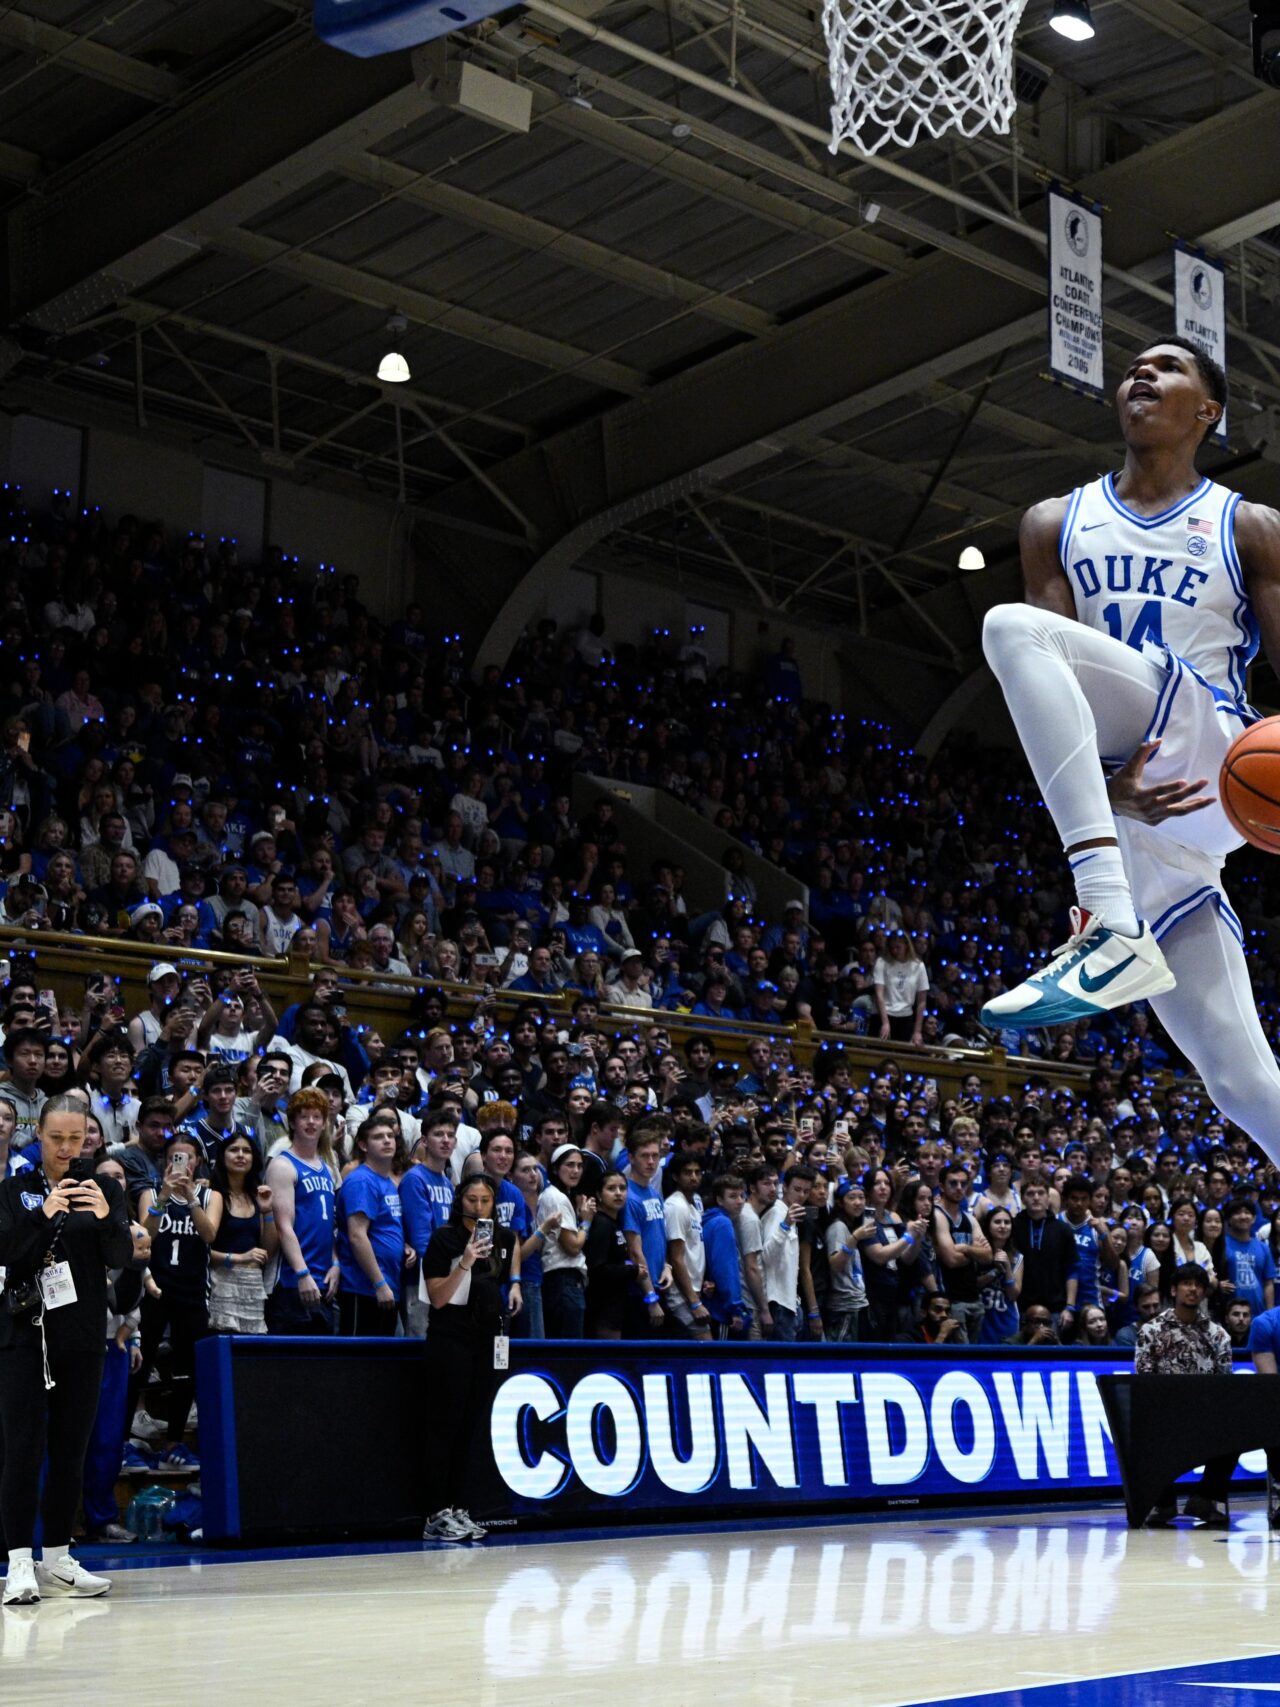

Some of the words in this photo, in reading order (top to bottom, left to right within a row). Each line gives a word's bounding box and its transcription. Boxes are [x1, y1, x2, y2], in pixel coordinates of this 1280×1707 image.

[1060, 266, 1094, 292] ATLANTIC
[1065, 285, 1090, 305] COAST
[1053, 295, 1103, 328] CONFERENCE
[1056, 312, 1101, 343] CHAMPIONS
[1184, 318, 1219, 344] ATLANTIC
[1073, 555, 1209, 607] DUKE
[1102, 600, 1164, 653] 14
[319, 1194, 328, 1221] 1
[158, 1213, 199, 1236] Duk
[170, 1239, 180, 1265] 1
[983, 1287, 1008, 1312] 30
[476, 1519, 518, 1527] DAKTRONICS
